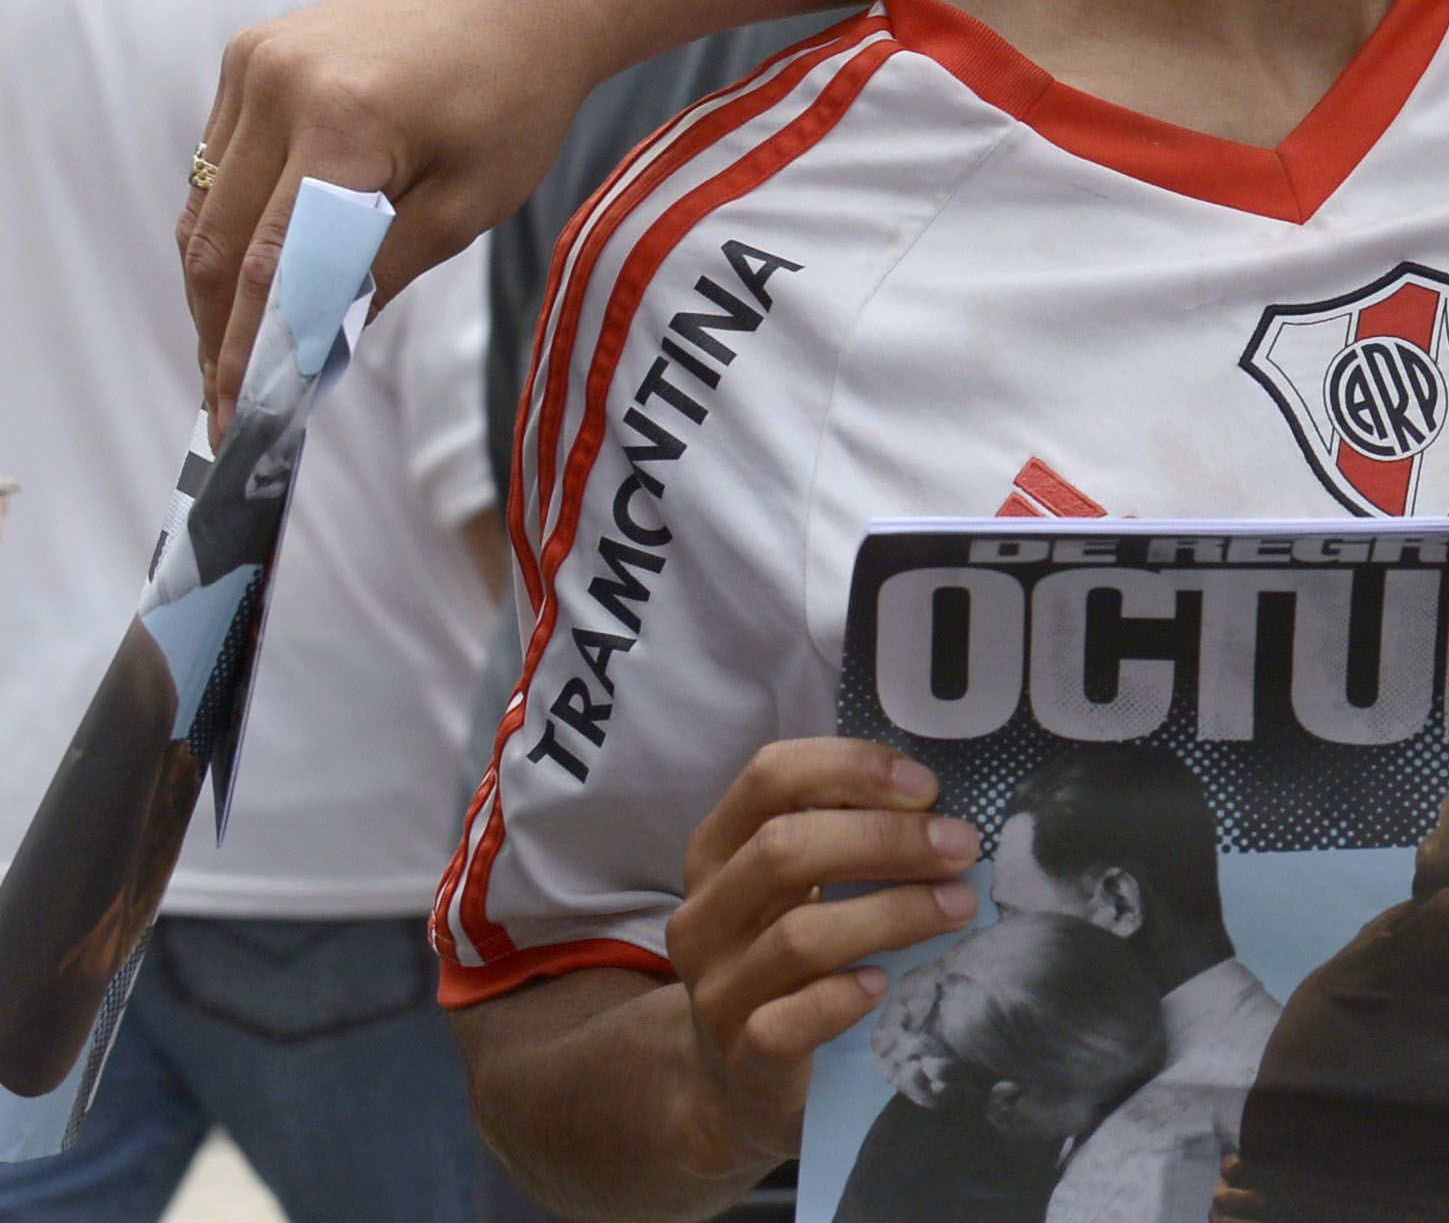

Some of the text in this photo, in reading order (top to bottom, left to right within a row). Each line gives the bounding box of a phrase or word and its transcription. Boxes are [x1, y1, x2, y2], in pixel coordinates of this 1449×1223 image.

[1329, 342, 1438, 456] CARP
[527, 239, 806, 785] TRAMONTINA
[967, 537, 1121, 564] DE
